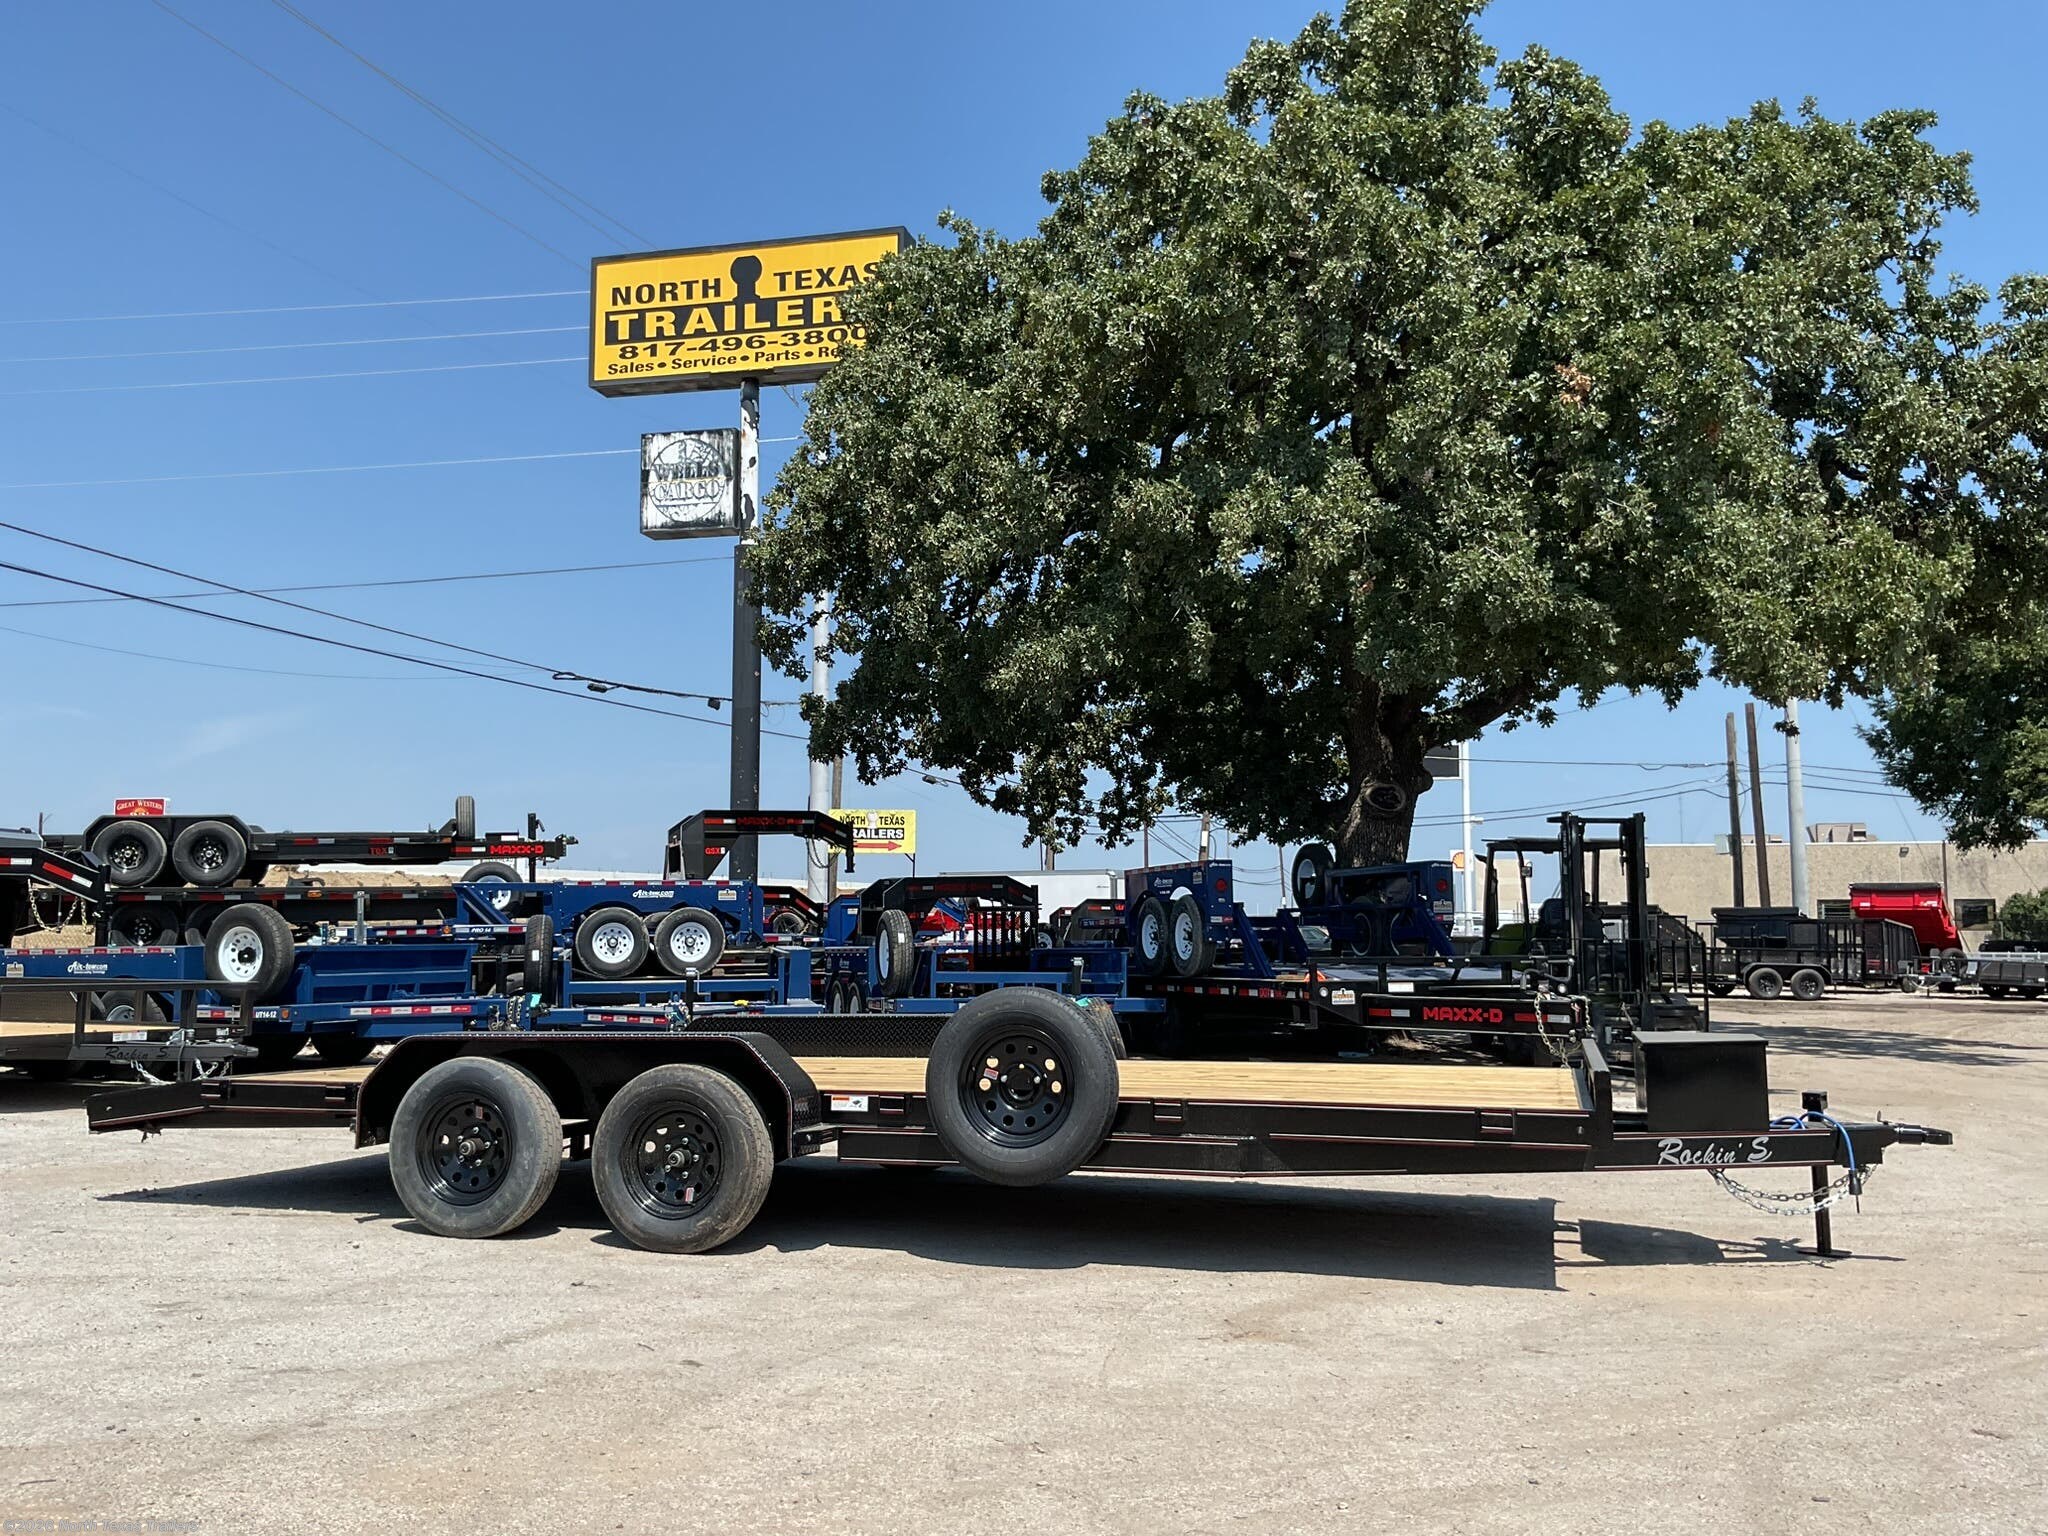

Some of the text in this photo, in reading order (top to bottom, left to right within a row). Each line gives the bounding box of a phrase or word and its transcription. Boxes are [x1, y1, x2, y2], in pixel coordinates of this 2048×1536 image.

[611, 261, 880, 306] NORTH TEXAS
[609, 296, 844, 341] TRAILER
[618, 327, 867, 360] 817-496-3800
[607, 350, 801, 375] Sales Service Parts
[653, 480, 721, 501] CARGO
[116, 801, 136, 810] GREAT
[840, 815, 905, 825] NORTH TEXAS
[853, 828, 904, 838] RAILERS
[490, 844, 545, 855] MAXX-D
[1422, 1006, 1503, 1023] MAXX-D
[1658, 1136, 1773, 1164] Rockin' S
